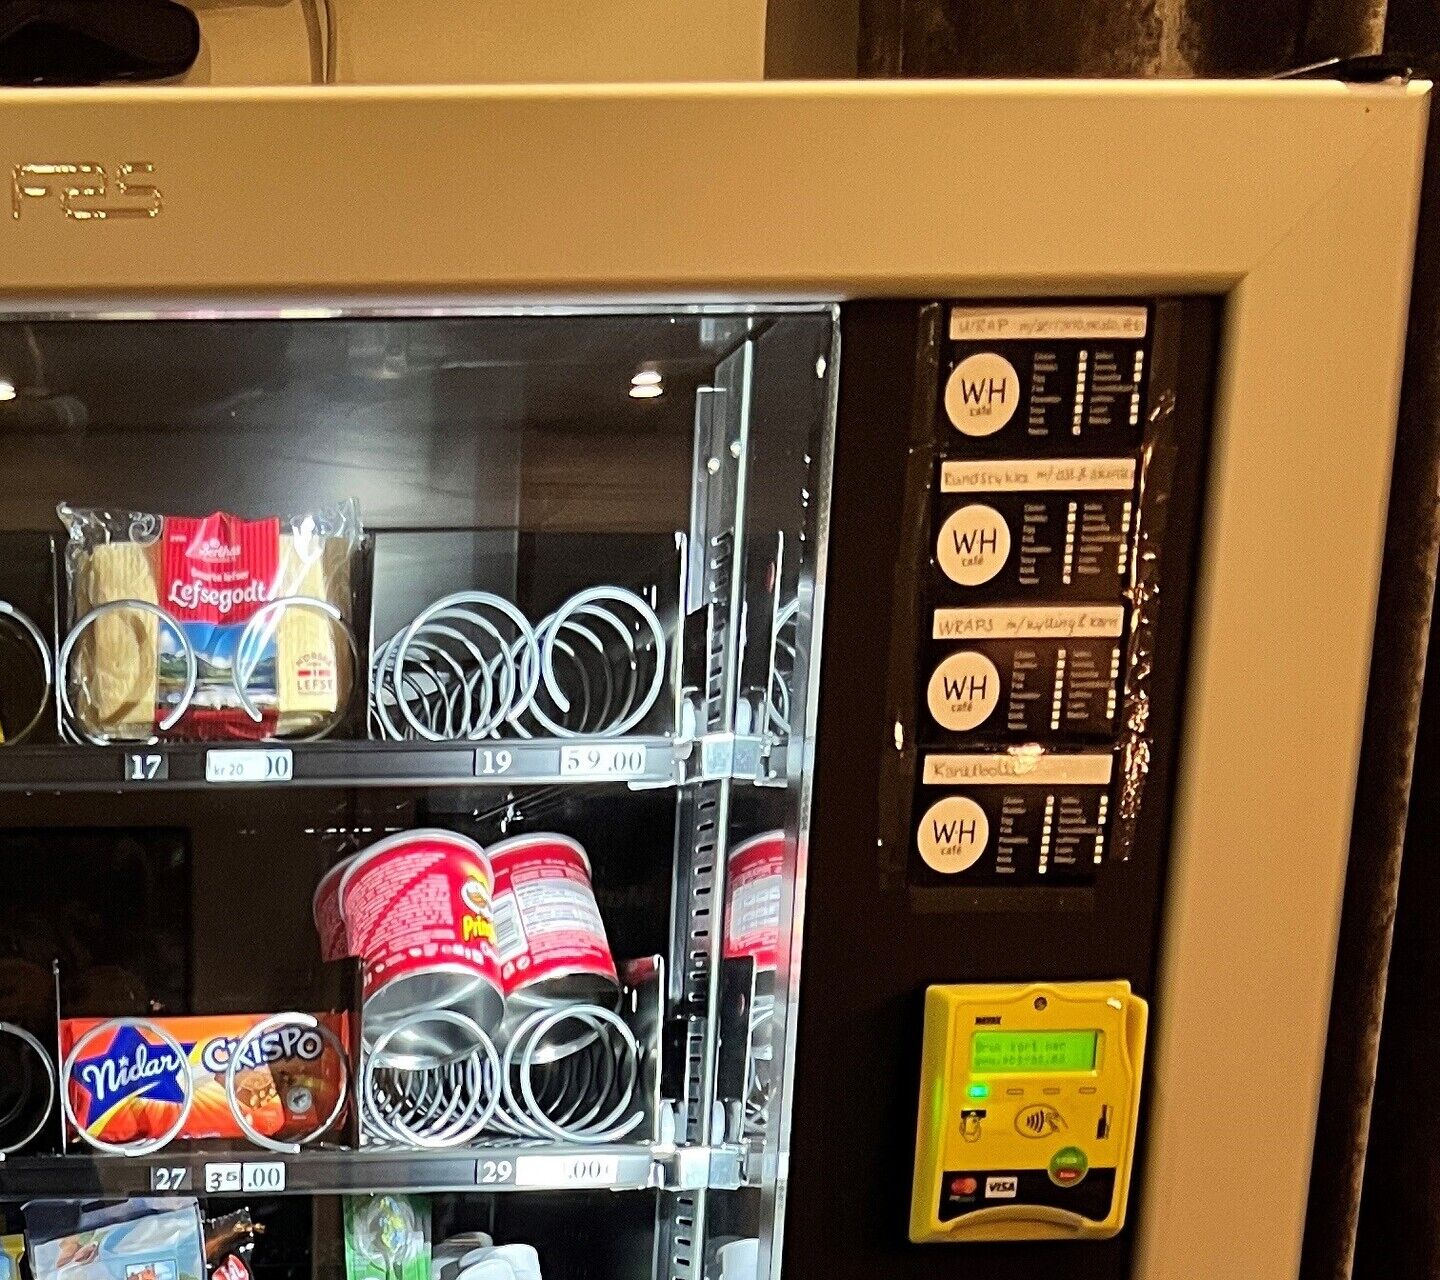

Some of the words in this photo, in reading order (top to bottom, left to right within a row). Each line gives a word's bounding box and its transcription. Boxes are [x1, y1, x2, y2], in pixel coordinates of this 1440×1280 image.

[961, 378, 1006, 404] WH
[953, 528, 997, 554] WH
[944, 675, 987, 700] WH
[131, 755, 162, 779] 17
[483, 749, 513, 773] 19
[568, 748, 642, 772] 59.00
[933, 820, 976, 845] WH
[201, 1025, 324, 1074] CRISPO
[81, 1043, 183, 1101] Nidar
[155, 1168, 187, 1190] 27
[483, 1160, 513, 1182] 29
[988, 1181, 1016, 1194] VISA
